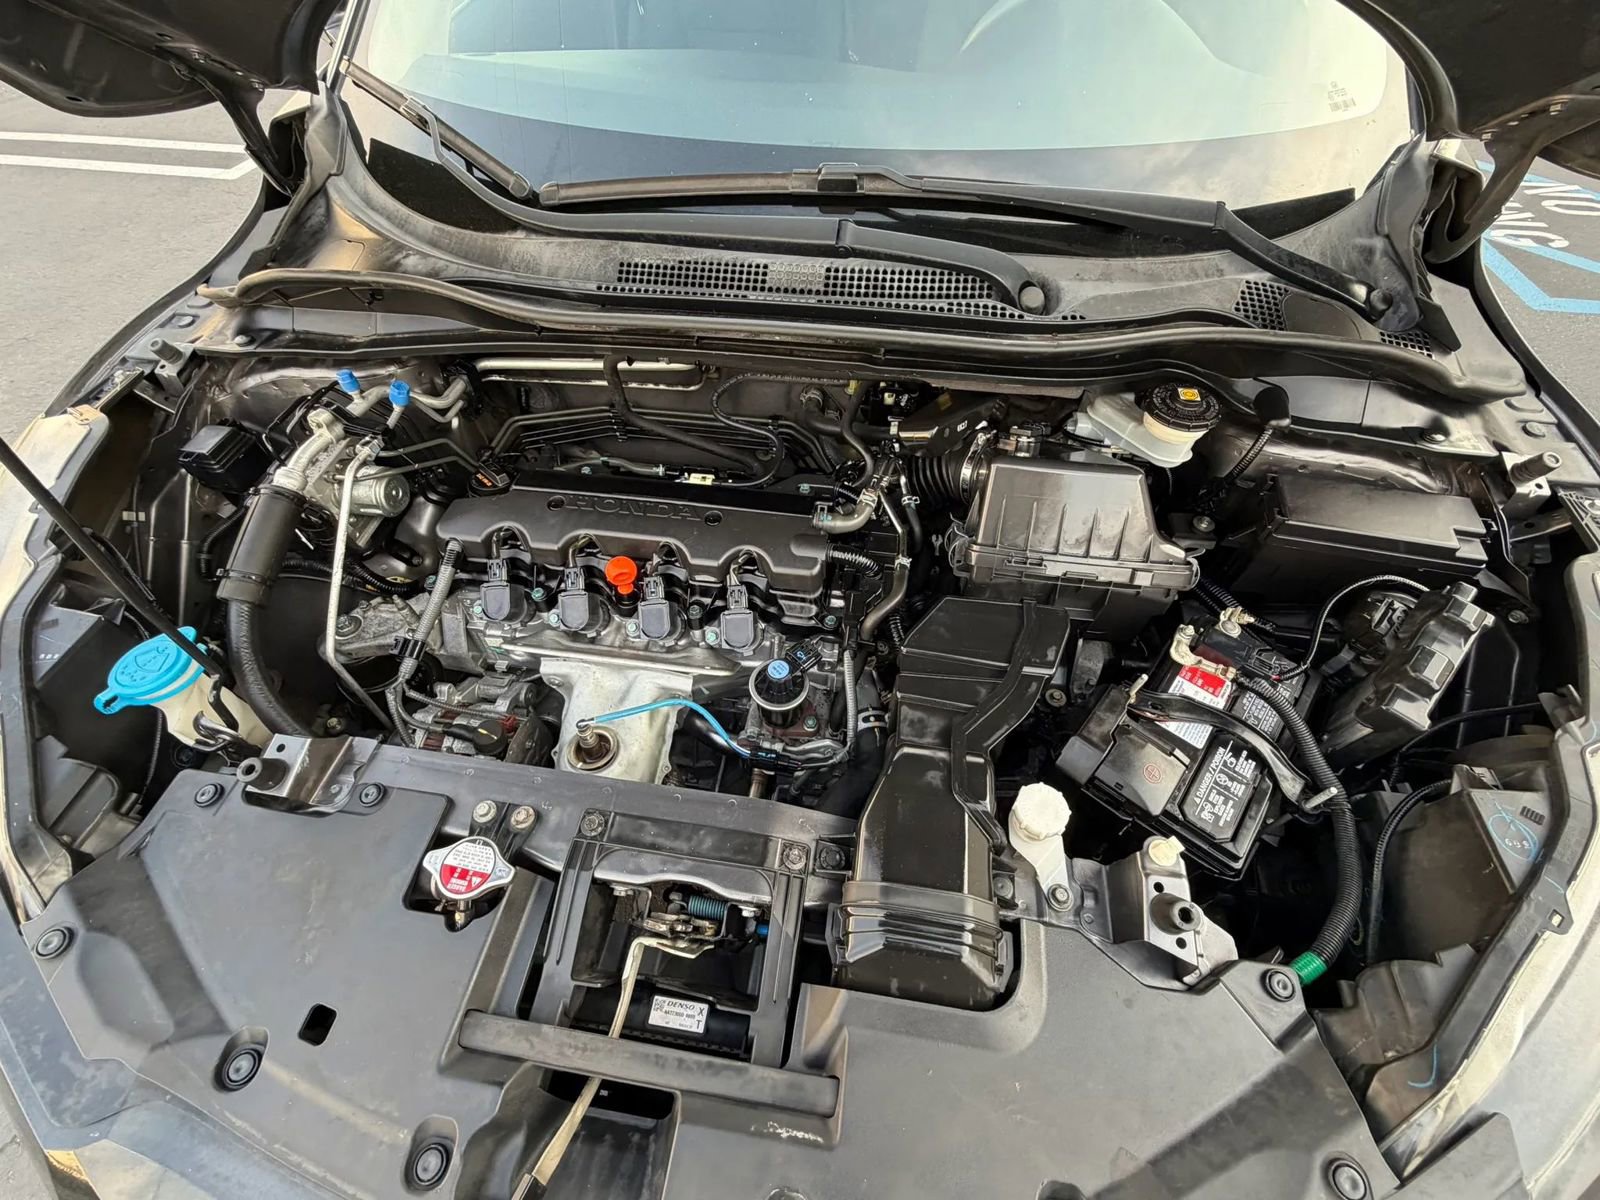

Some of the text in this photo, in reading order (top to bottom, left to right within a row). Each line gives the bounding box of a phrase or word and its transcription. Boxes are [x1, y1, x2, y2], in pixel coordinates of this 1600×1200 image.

[566, 496, 700, 521] HONDA
[1196, 772, 1212, 797] DANGER
[1210, 746, 1225, 769] POISON
[667, 1000, 695, 1010] DENSO
[697, 1007, 704, 1016] X
